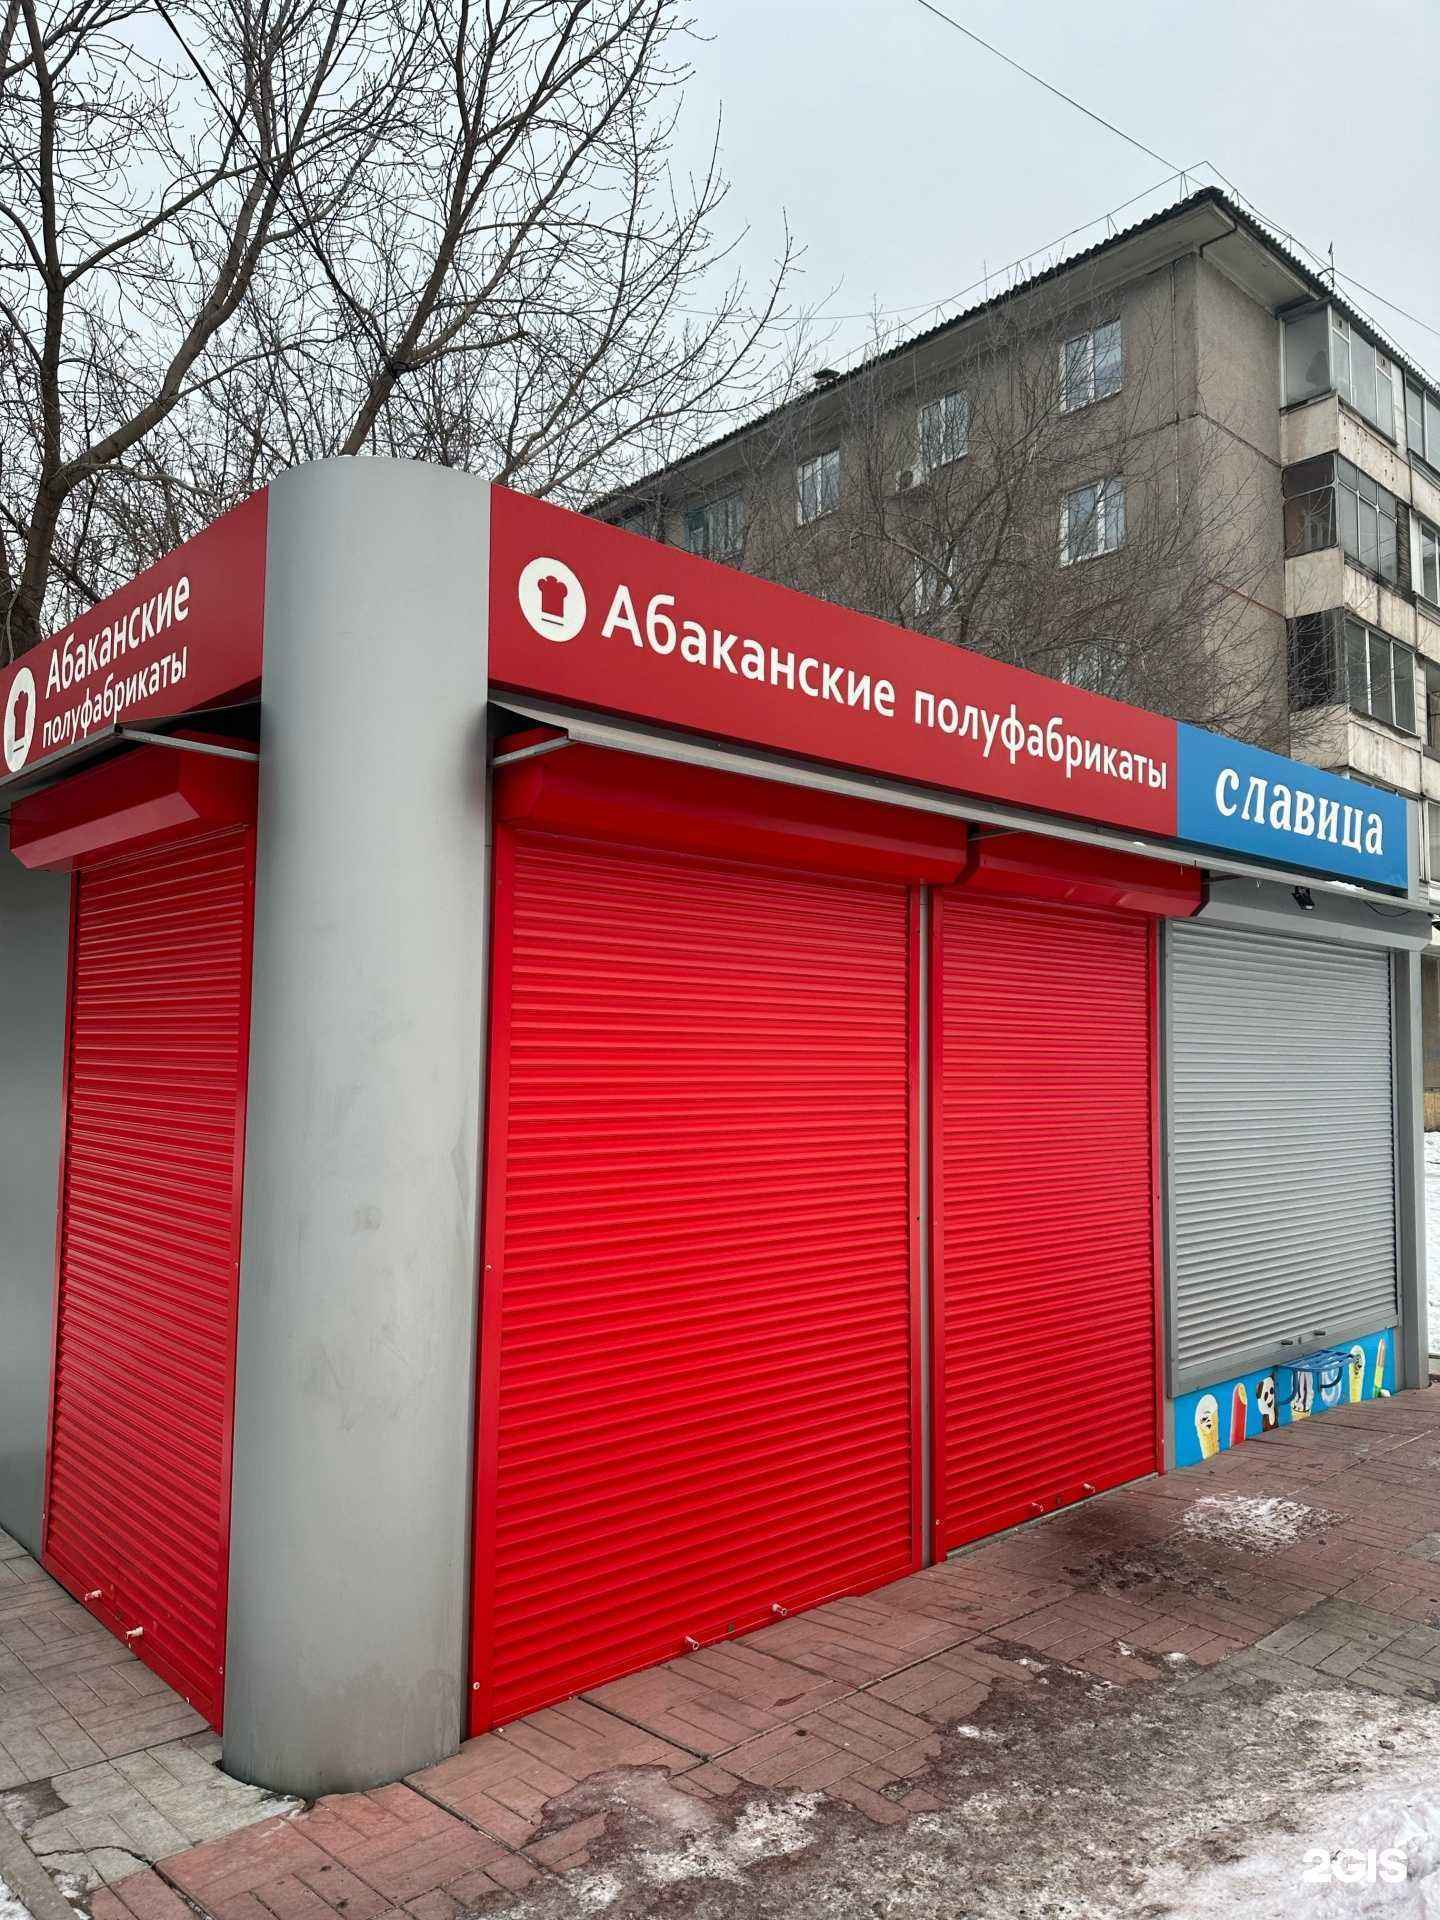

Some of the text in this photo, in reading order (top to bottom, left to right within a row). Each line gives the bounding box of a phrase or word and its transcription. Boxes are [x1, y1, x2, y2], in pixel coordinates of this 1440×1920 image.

[41, 645, 189, 749] полуфабрикаты
[45, 575, 191, 699] Абаканские
[599, 584, 1168, 791] Абаканские полуфабрикаты
